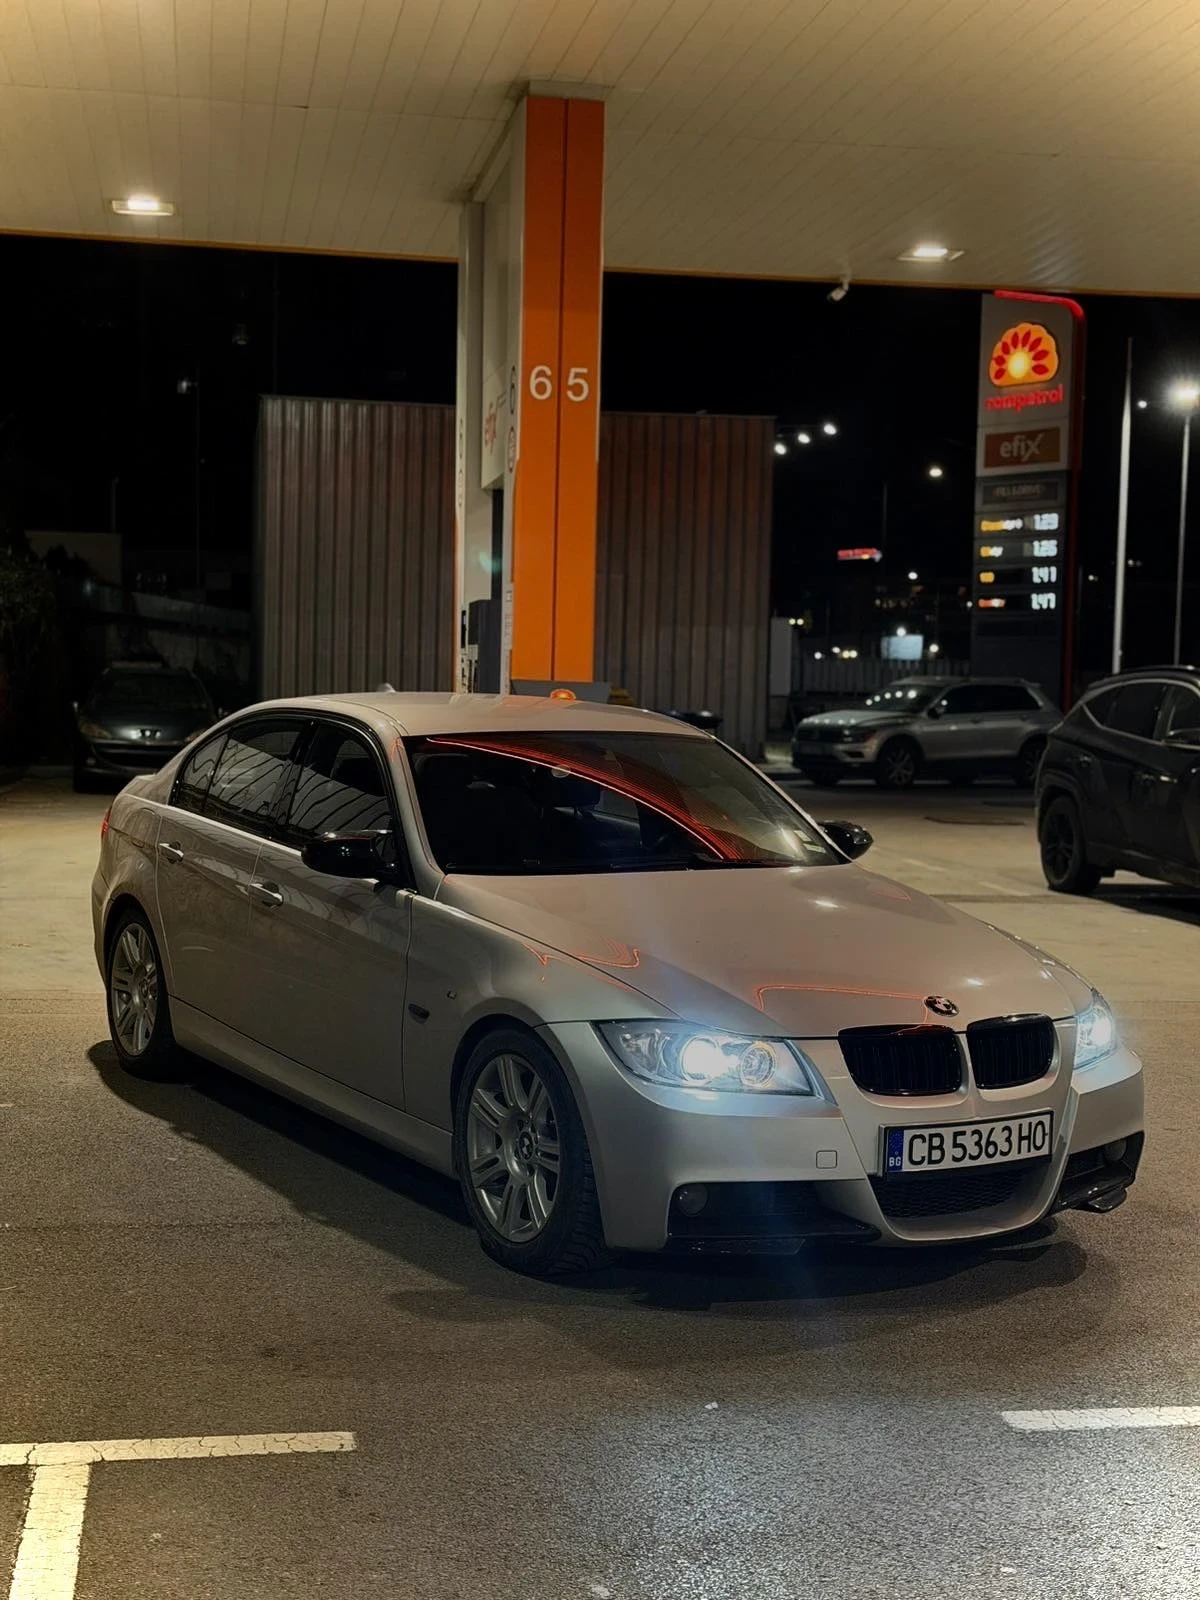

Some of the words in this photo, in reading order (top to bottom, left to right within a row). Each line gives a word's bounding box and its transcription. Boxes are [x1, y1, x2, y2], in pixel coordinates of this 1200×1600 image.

[529, 365, 553, 401] 6
[566, 367, 589, 403] 5
[1000, 433, 1044, 461] efix
[908, 1132, 946, 1166] CB
[951, 1125, 1013, 1163] 5363
[1018, 1120, 1046, 1154] HO
[889, 1156, 902, 1167] BG
